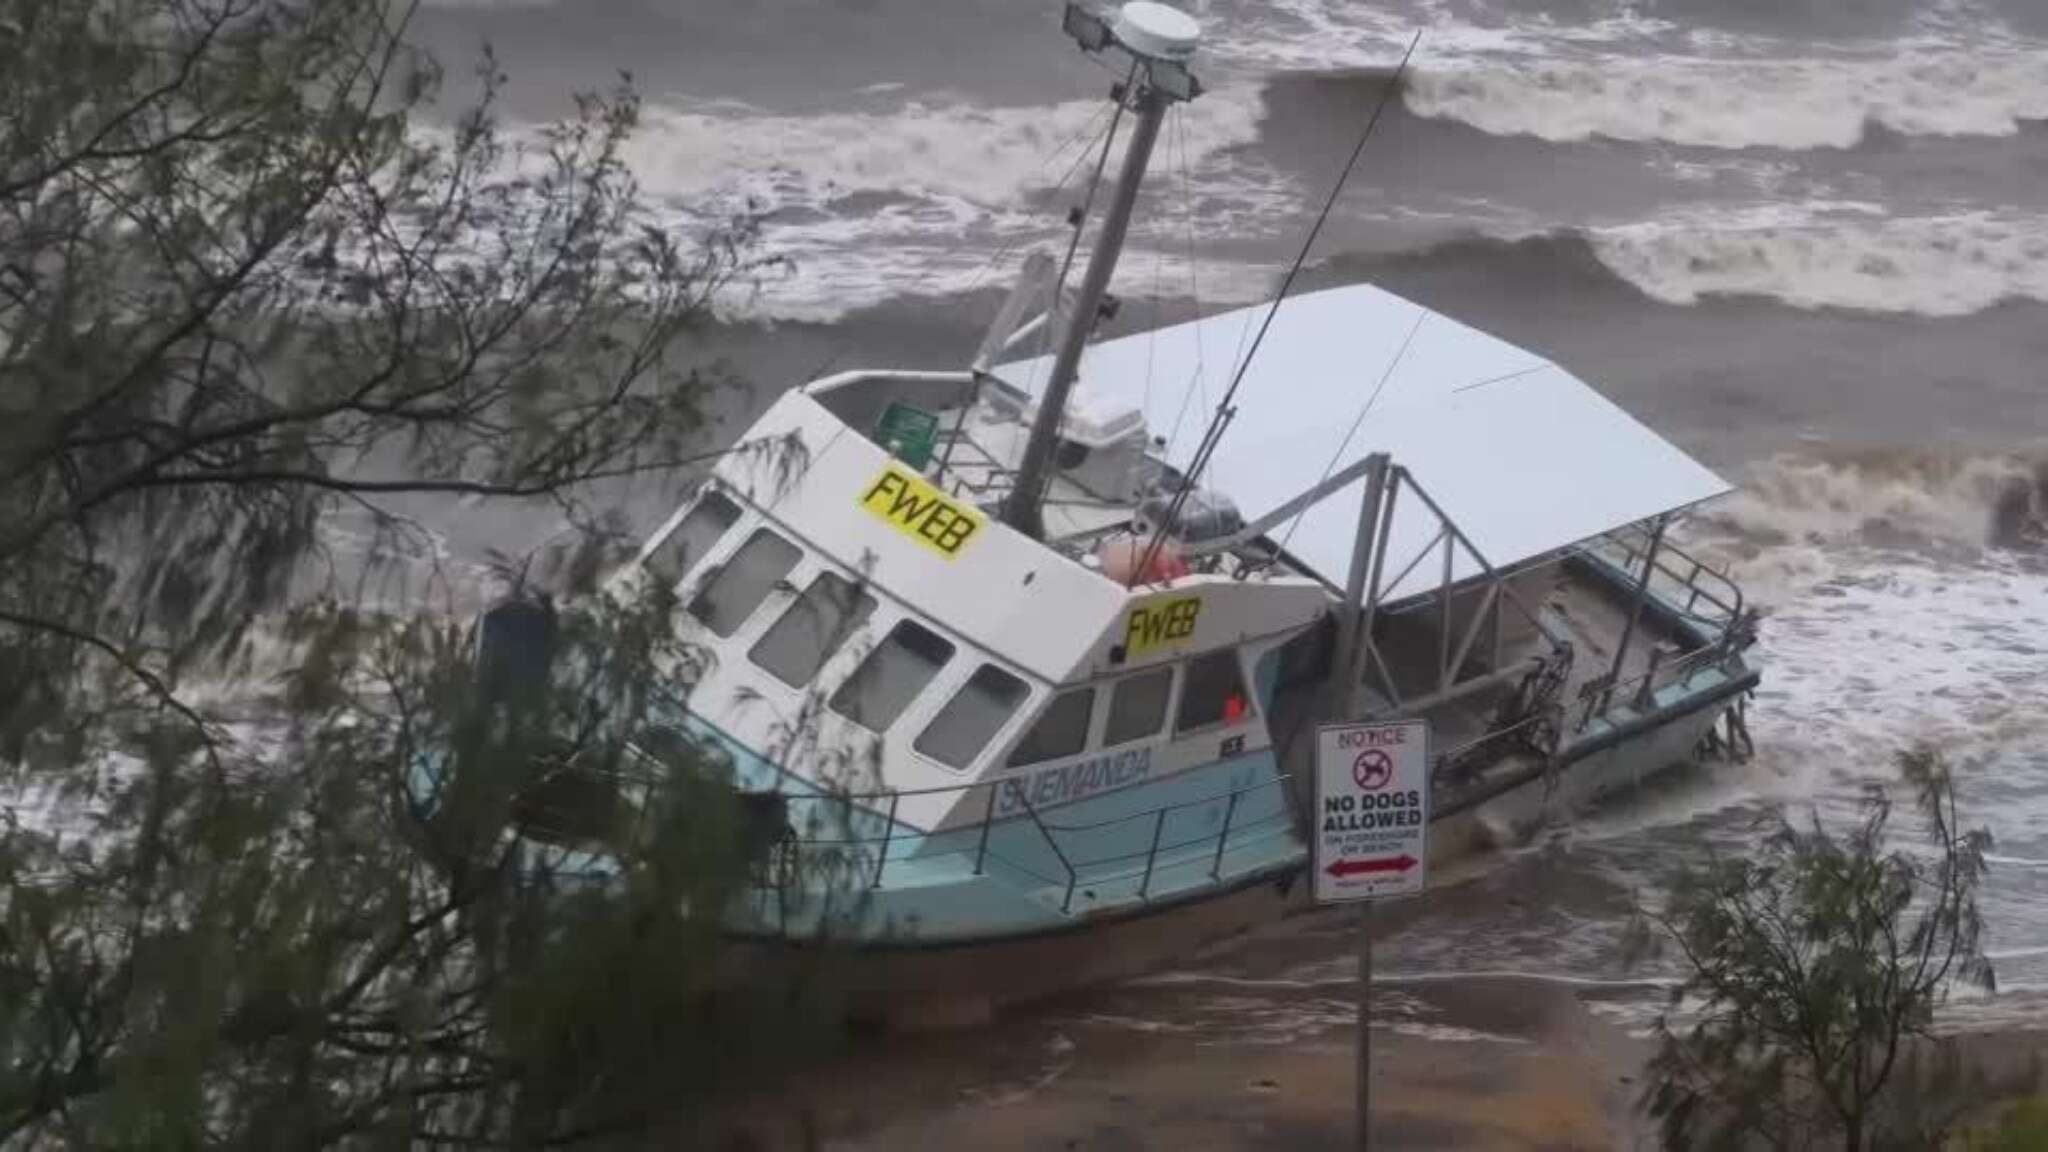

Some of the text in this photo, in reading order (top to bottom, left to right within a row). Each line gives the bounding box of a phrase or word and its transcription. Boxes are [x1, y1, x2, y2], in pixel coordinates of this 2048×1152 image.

[864, 471, 976, 553] FWEB
[1125, 597, 1202, 650] FWEB
[1338, 729, 1405, 749] NOTICE
[1001, 747, 1153, 813] SUEMANDA
[1326, 791, 1419, 813] NO DOGS
[1324, 810, 1421, 832] ALLOWED
